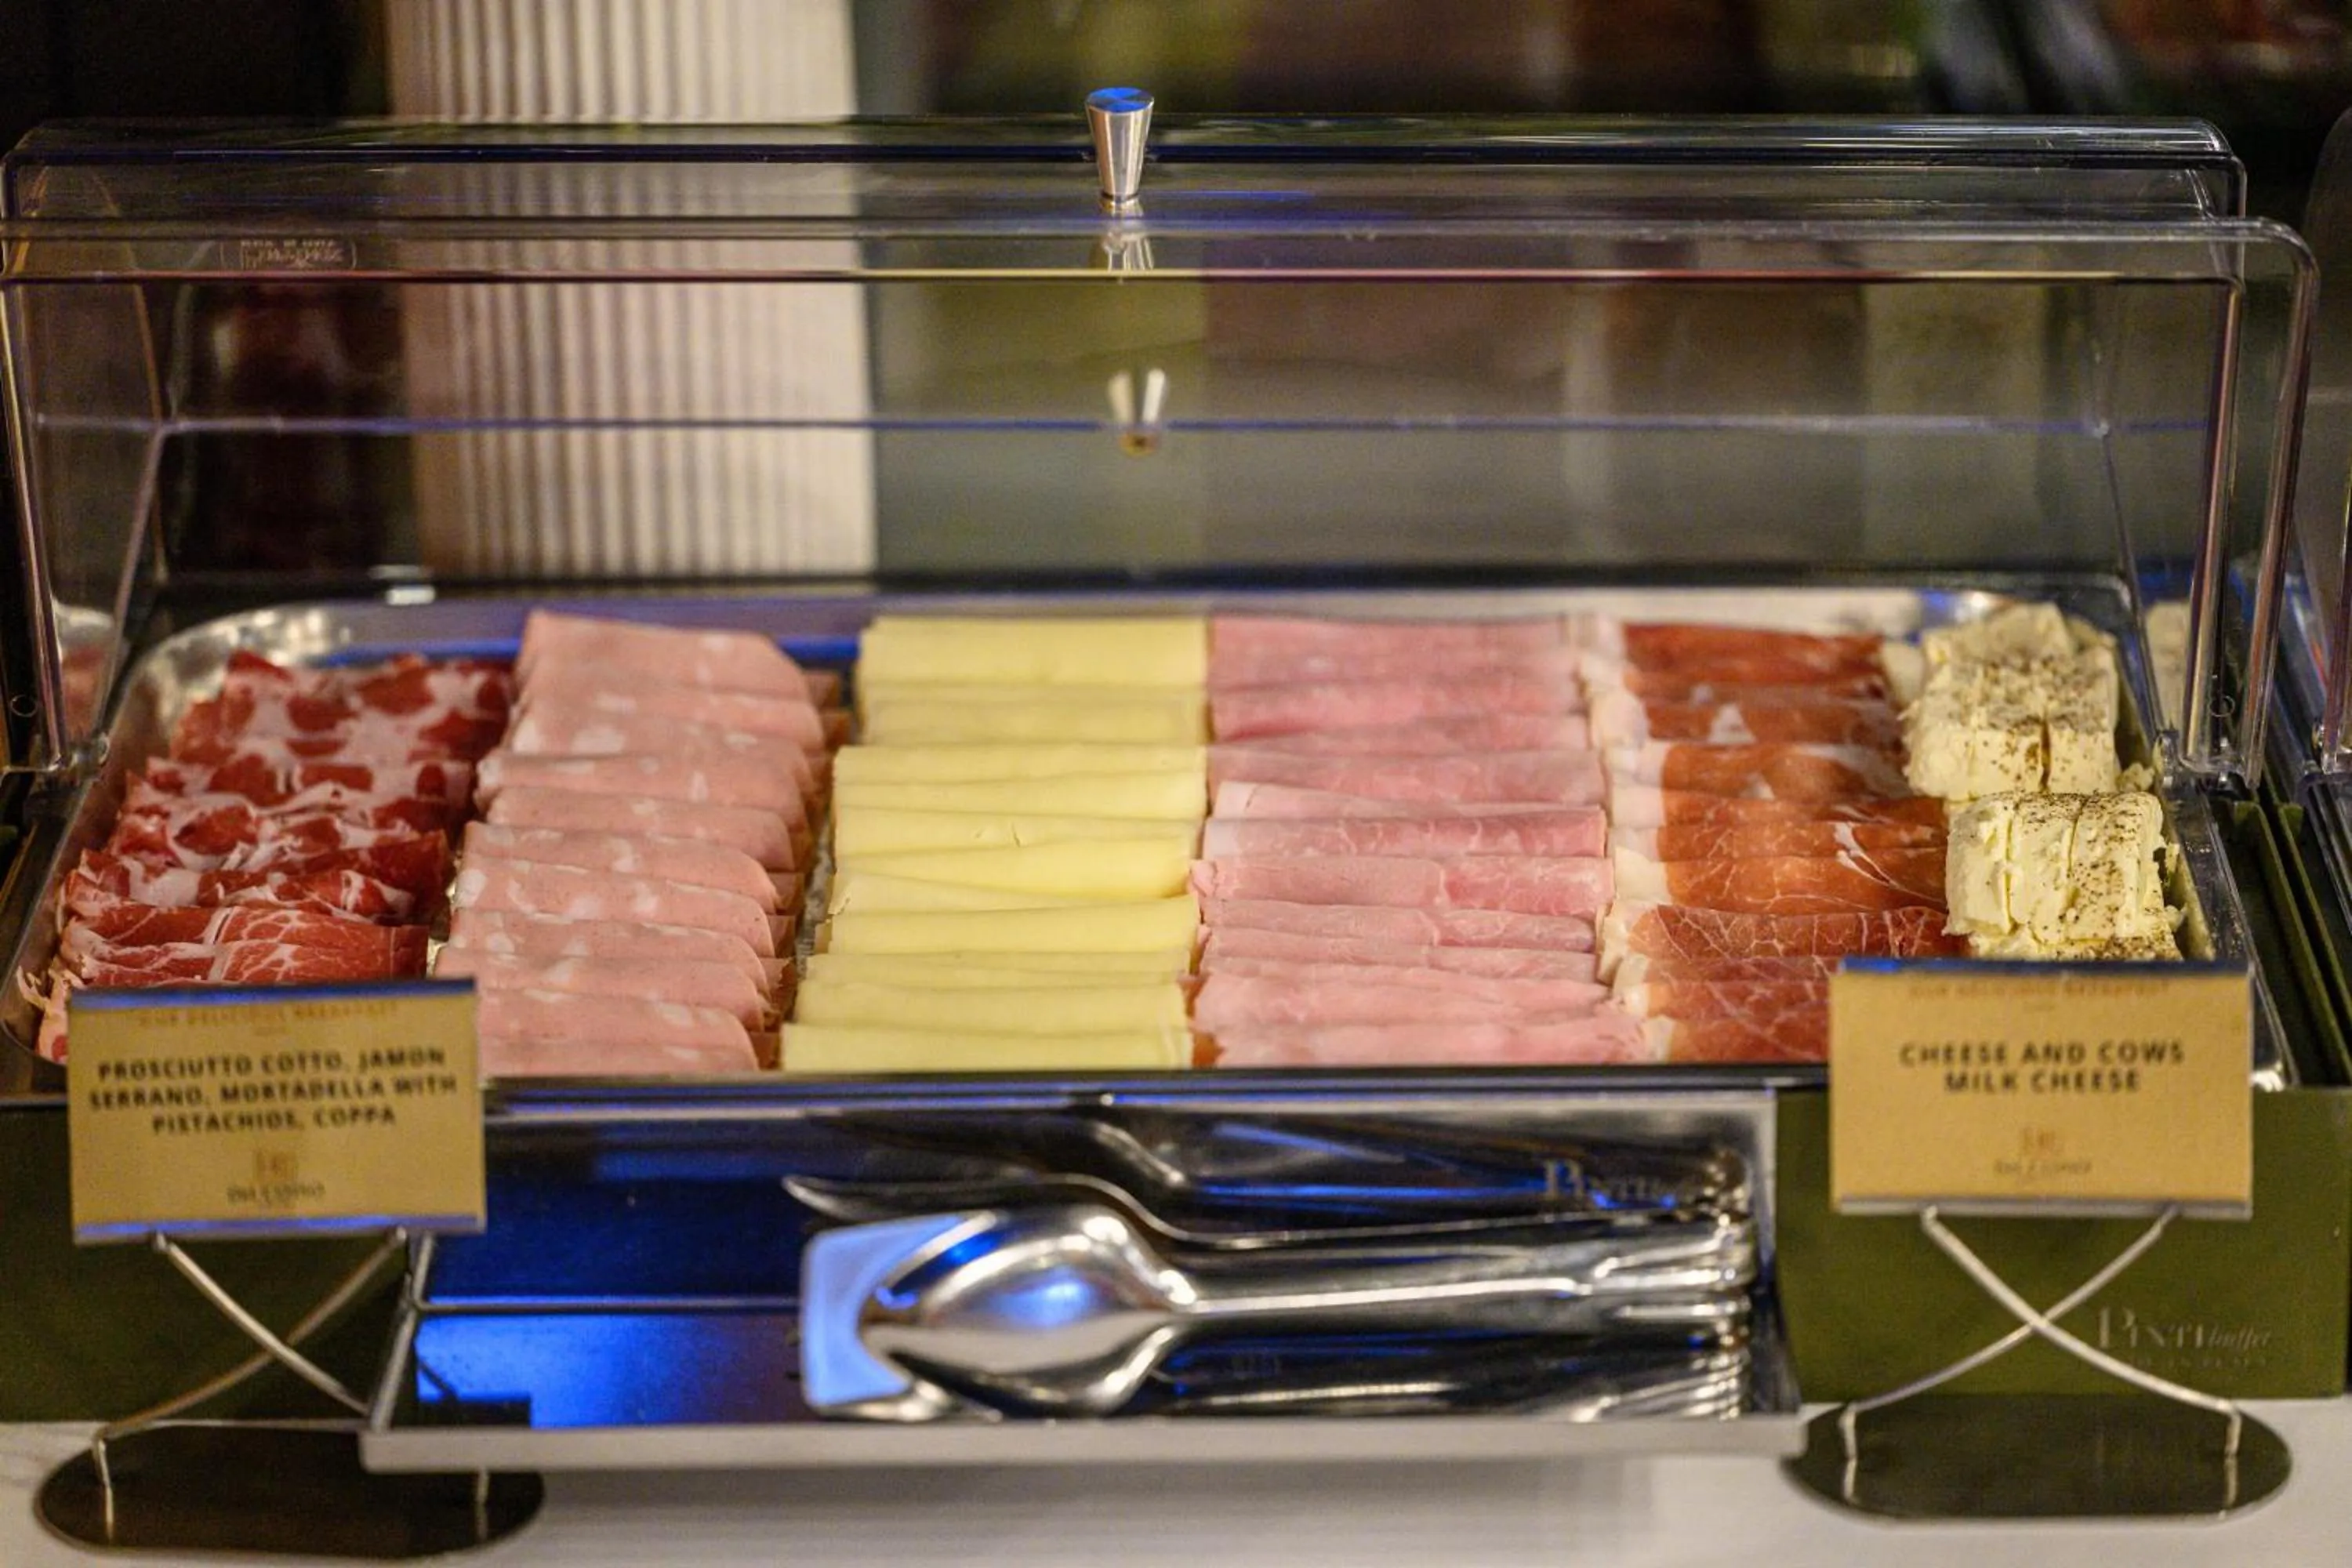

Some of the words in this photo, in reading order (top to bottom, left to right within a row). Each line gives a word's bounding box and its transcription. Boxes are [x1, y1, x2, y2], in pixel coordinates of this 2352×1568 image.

[97, 1054, 252, 1082] PROSCIUTTO
[358, 1043, 446, 1074] JAMON
[1898, 1041, 2006, 1067] CHEESE
[2020, 1040, 2087, 1065] AND
[2096, 1038, 2186, 1066] COWS
[219, 1077, 385, 1105] MORTADELLA
[394, 1072, 458, 1096] WITH
[1943, 1069, 2018, 1094] MILK
[2029, 1069, 2140, 1094] CHEESE
[314, 1103, 396, 1129] COPPA
